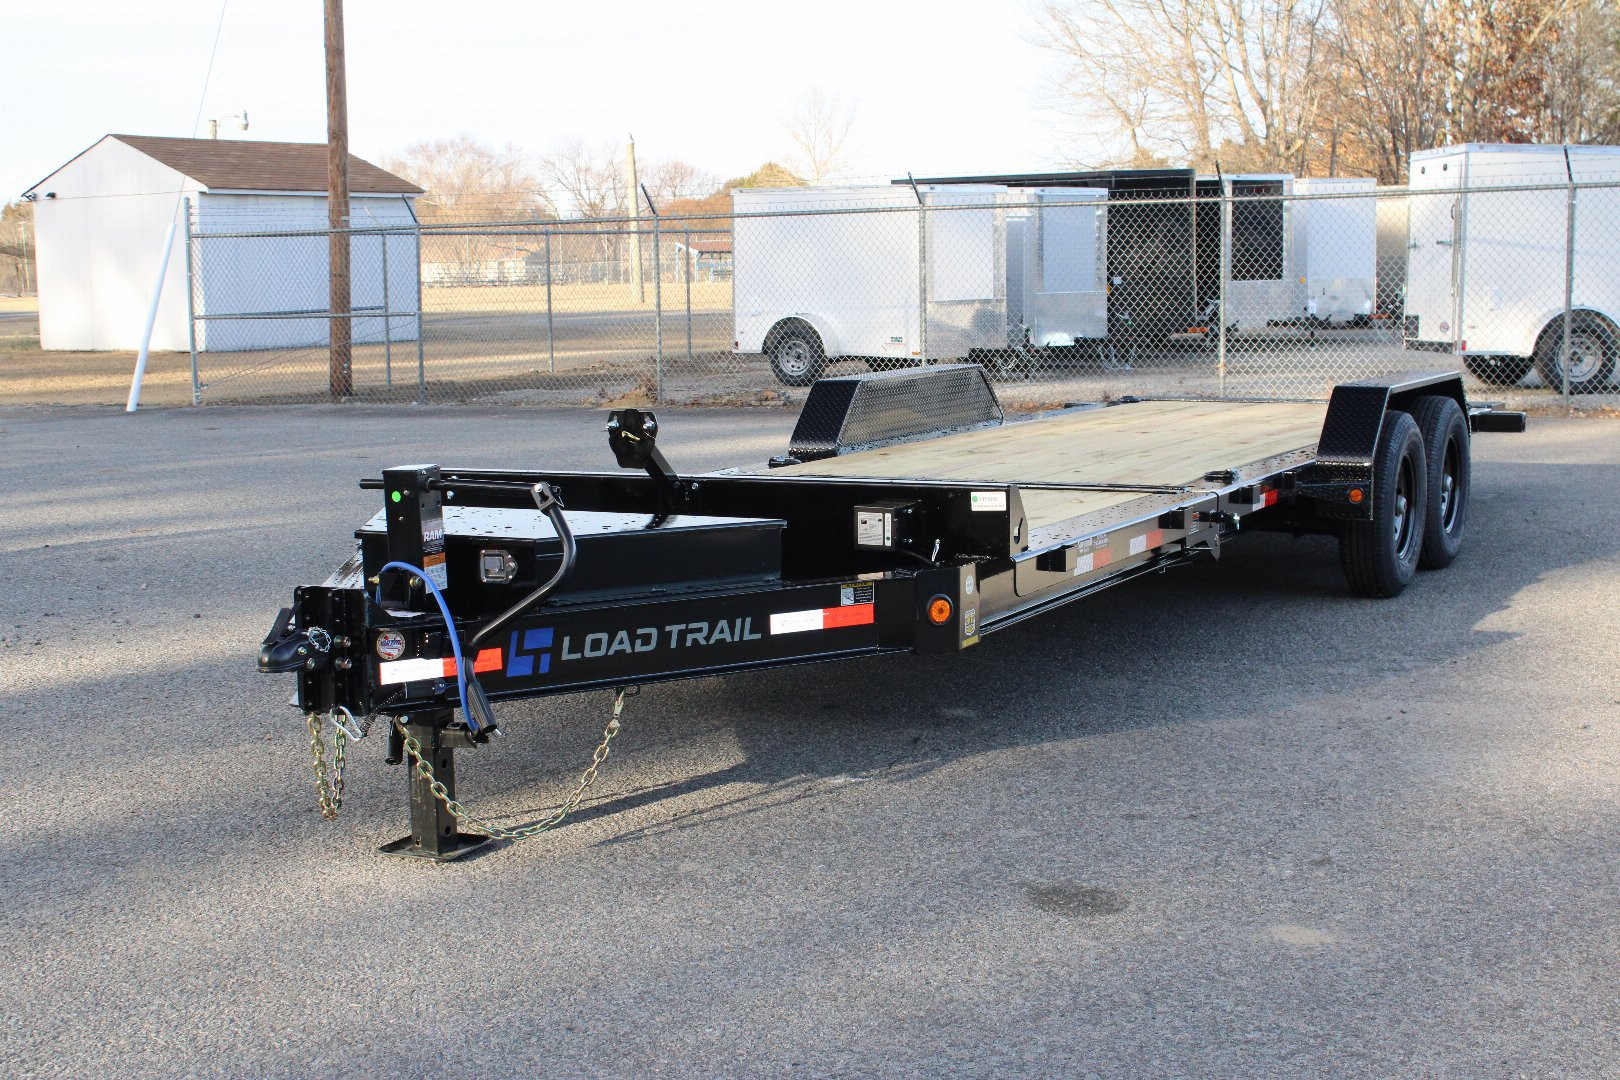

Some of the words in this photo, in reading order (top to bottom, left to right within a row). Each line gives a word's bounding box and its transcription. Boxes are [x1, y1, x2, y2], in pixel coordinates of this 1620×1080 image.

[423, 529, 443, 542] RAM
[561, 627, 658, 660] LOAD
[664, 617, 762, 649] TRAIL
